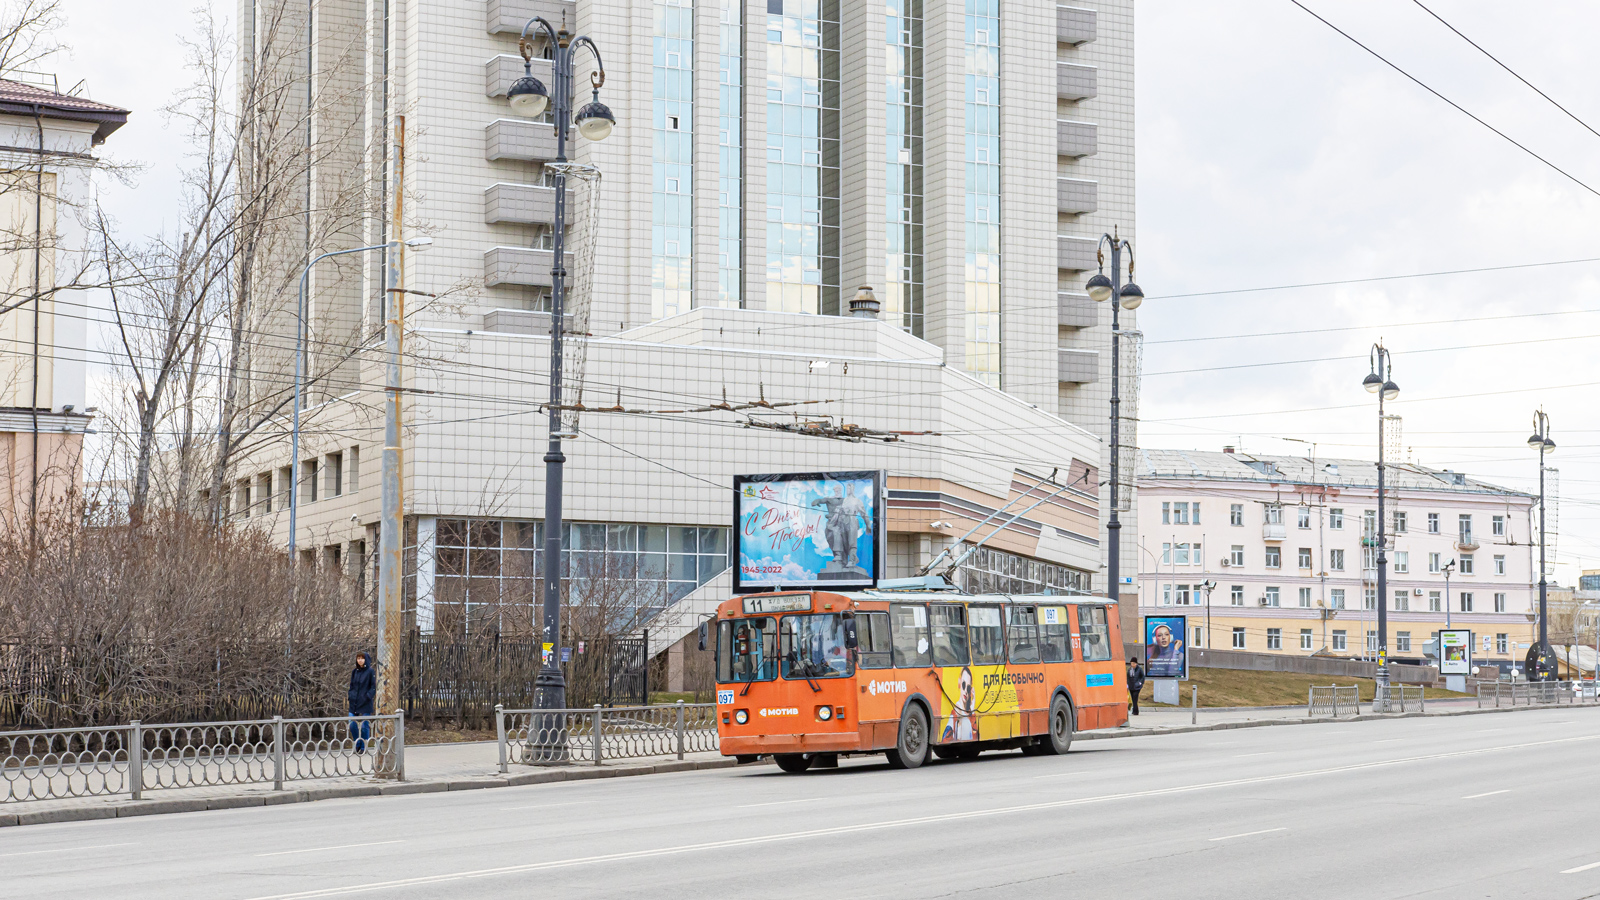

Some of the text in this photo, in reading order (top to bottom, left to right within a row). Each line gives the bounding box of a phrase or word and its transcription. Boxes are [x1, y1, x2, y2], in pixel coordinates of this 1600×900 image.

[745, 507, 799, 536] С Днём
[769, 514, 822, 552] Победы!
[750, 600, 763, 612] 11
[1071, 638, 1080, 648] 097
[983, 672, 1044, 689] ДЛЯ НЕОБЫЧНО
[876, 681, 907, 693] МОТИВ
[718, 694, 733, 704] 097
[767, 708, 799, 716] МОТИВ
